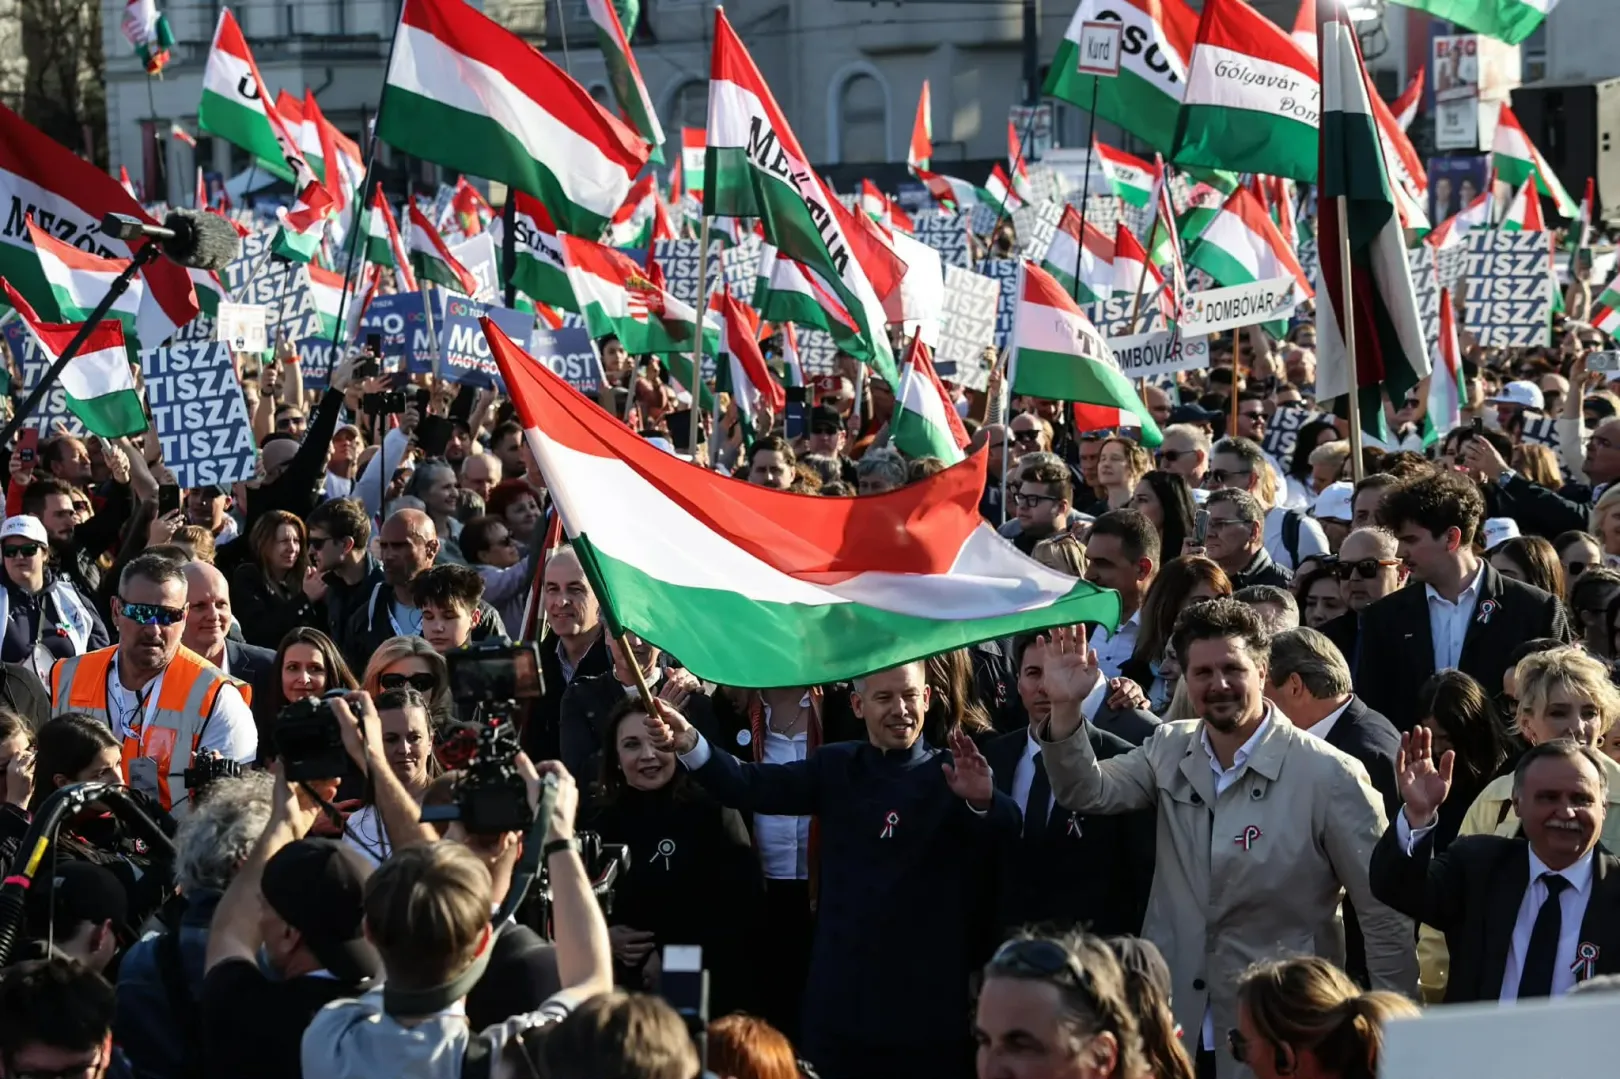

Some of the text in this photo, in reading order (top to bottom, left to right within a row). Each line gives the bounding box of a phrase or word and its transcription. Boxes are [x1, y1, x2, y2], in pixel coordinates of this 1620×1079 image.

[1087, 36, 1111, 61] Kurd
[1214, 59, 1300, 92] Gólyavár
[1469, 230, 1550, 251] TISZA
[1467, 253, 1550, 276] TISZA
[1465, 278, 1551, 300] TISZA
[1206, 289, 1274, 323] DOMBÓVÁR
[1464, 302, 1549, 325] TISZA
[137, 340, 232, 374] TISZA
[447, 351, 481, 370] VAGY
[144, 368, 241, 404] TISZA
[151, 397, 249, 433] TISZA
[158, 427, 254, 462] TISZA
[165, 455, 256, 489] TISZA
